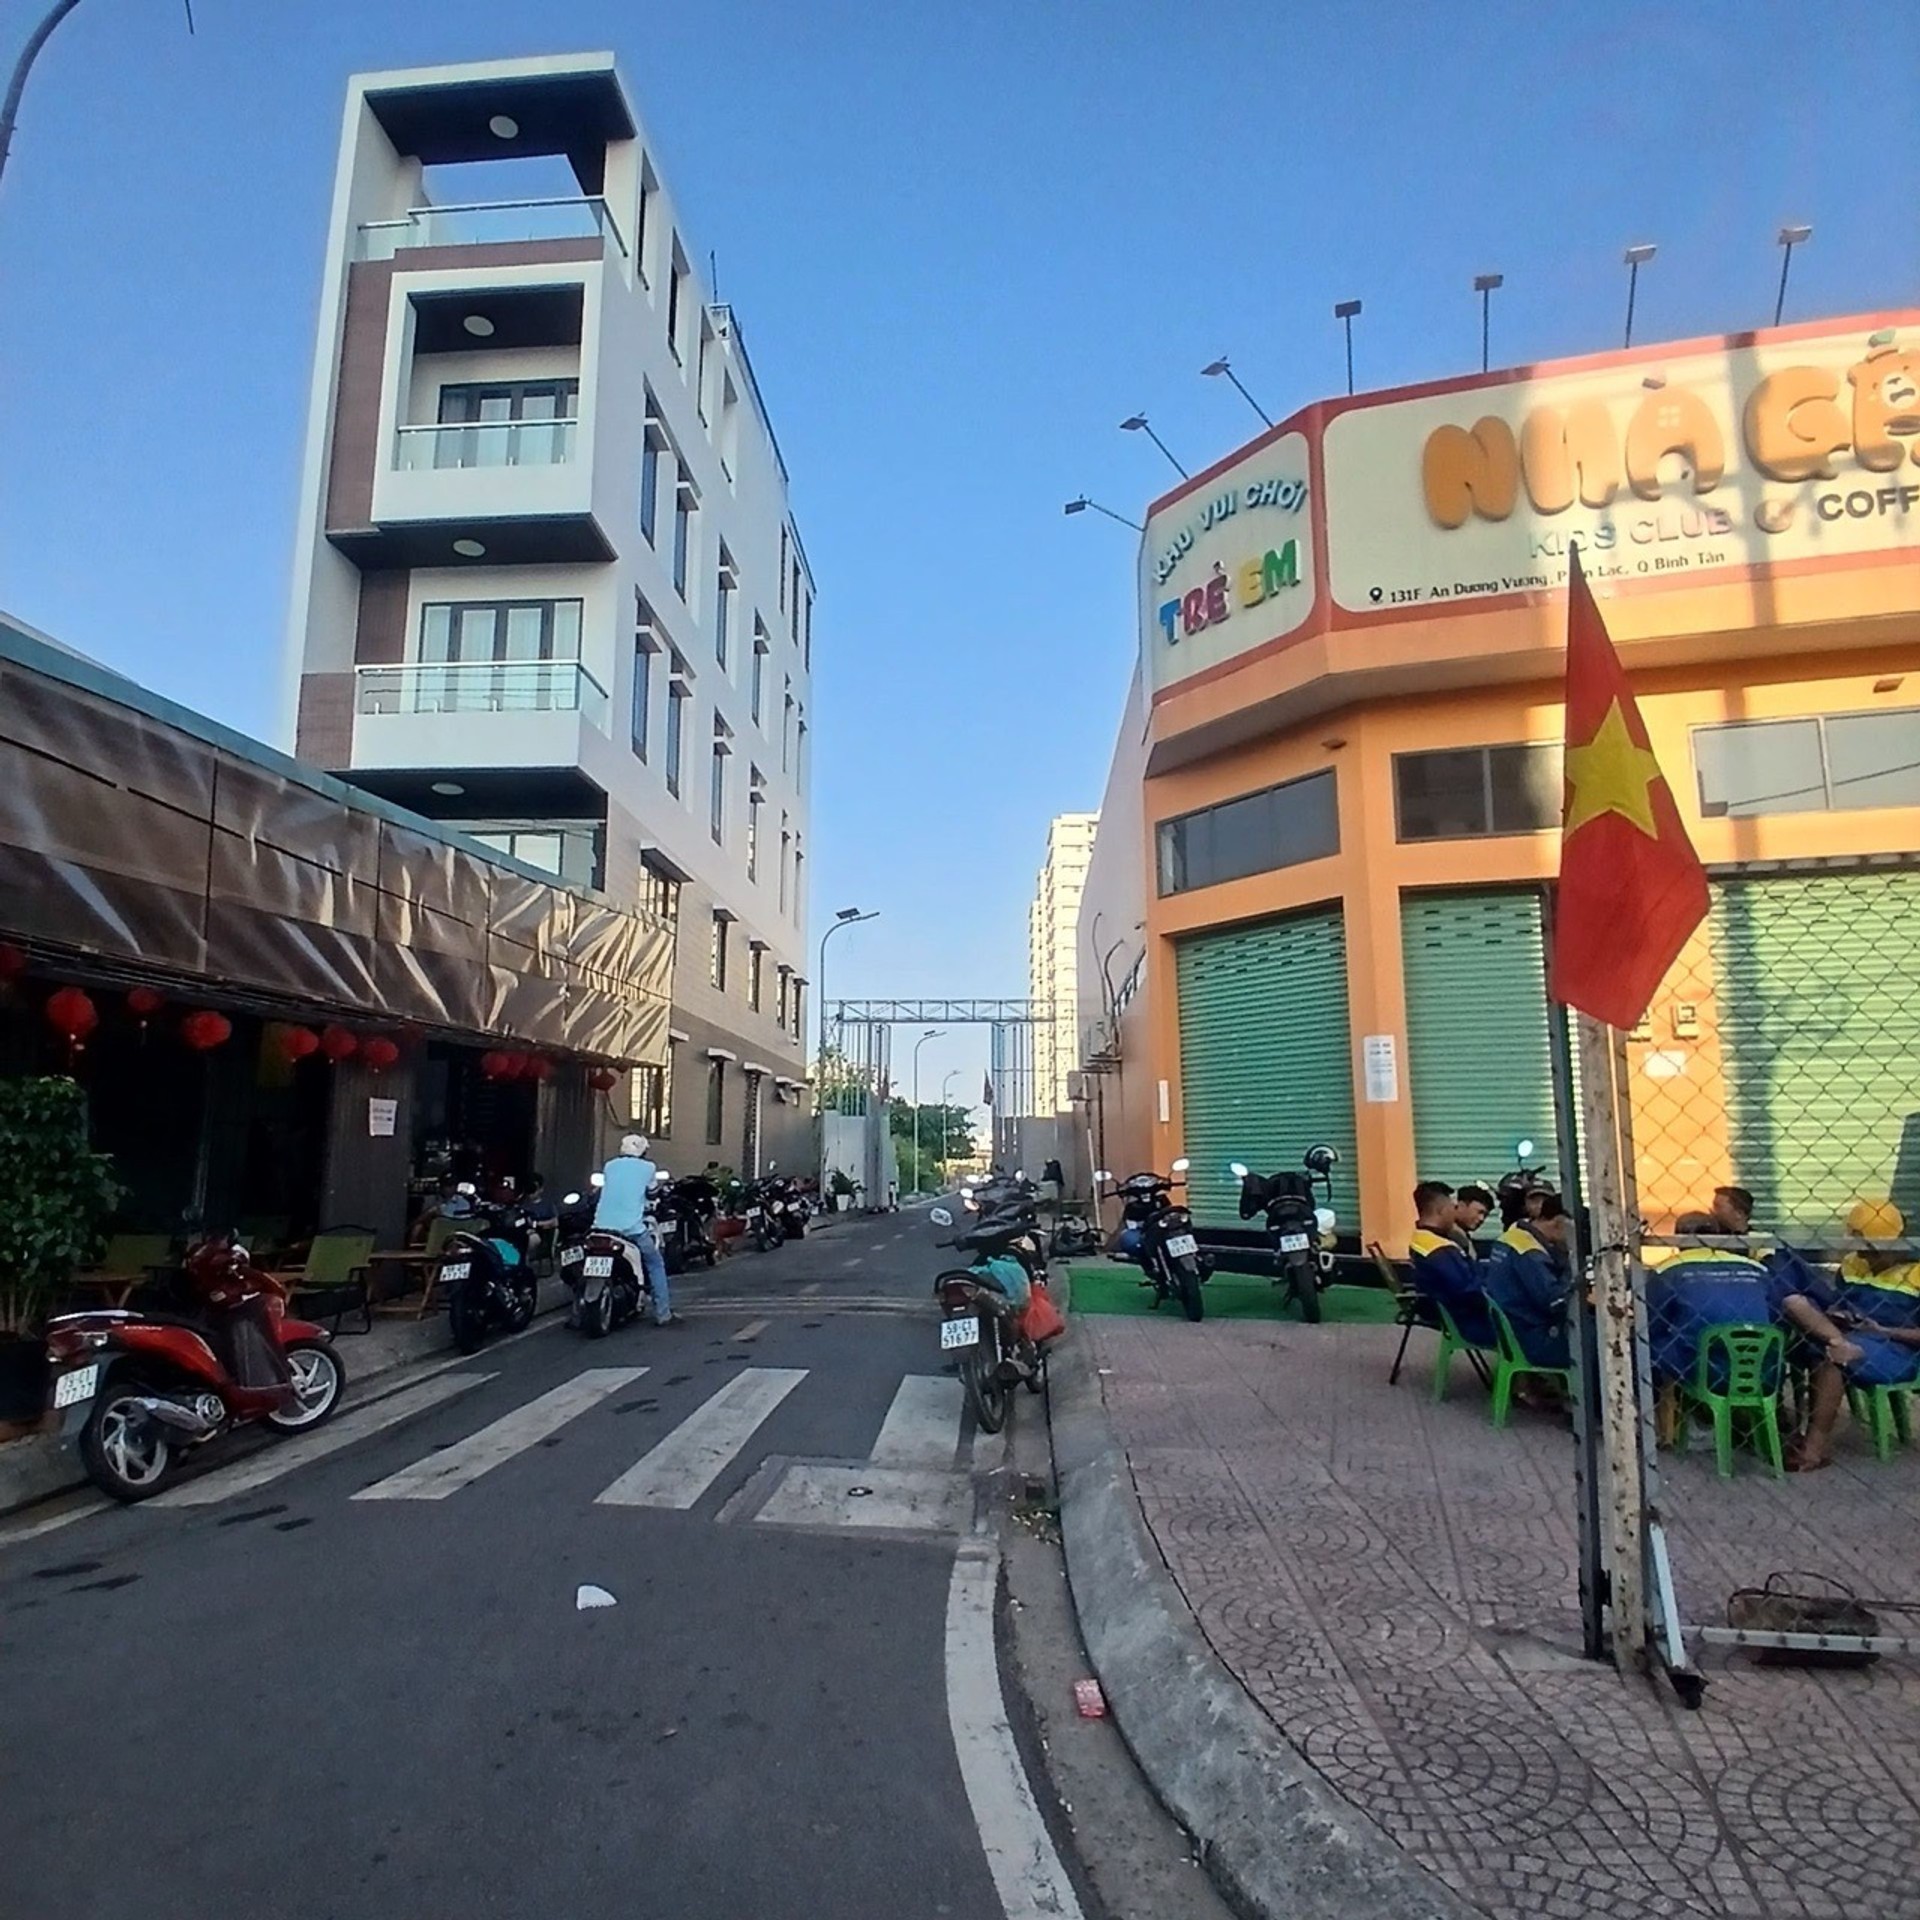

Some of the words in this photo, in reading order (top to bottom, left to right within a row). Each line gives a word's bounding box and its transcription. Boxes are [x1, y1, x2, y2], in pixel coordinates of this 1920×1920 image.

[1422, 377, 1726, 531] NHÀ
[1200, 488, 1239, 531] VUI
[1630, 507, 1732, 544] CLUB
[1238, 538, 1302, 608] EM
[1390, 587, 1422, 604] 131F
[1429, 585, 1450, 600] An
